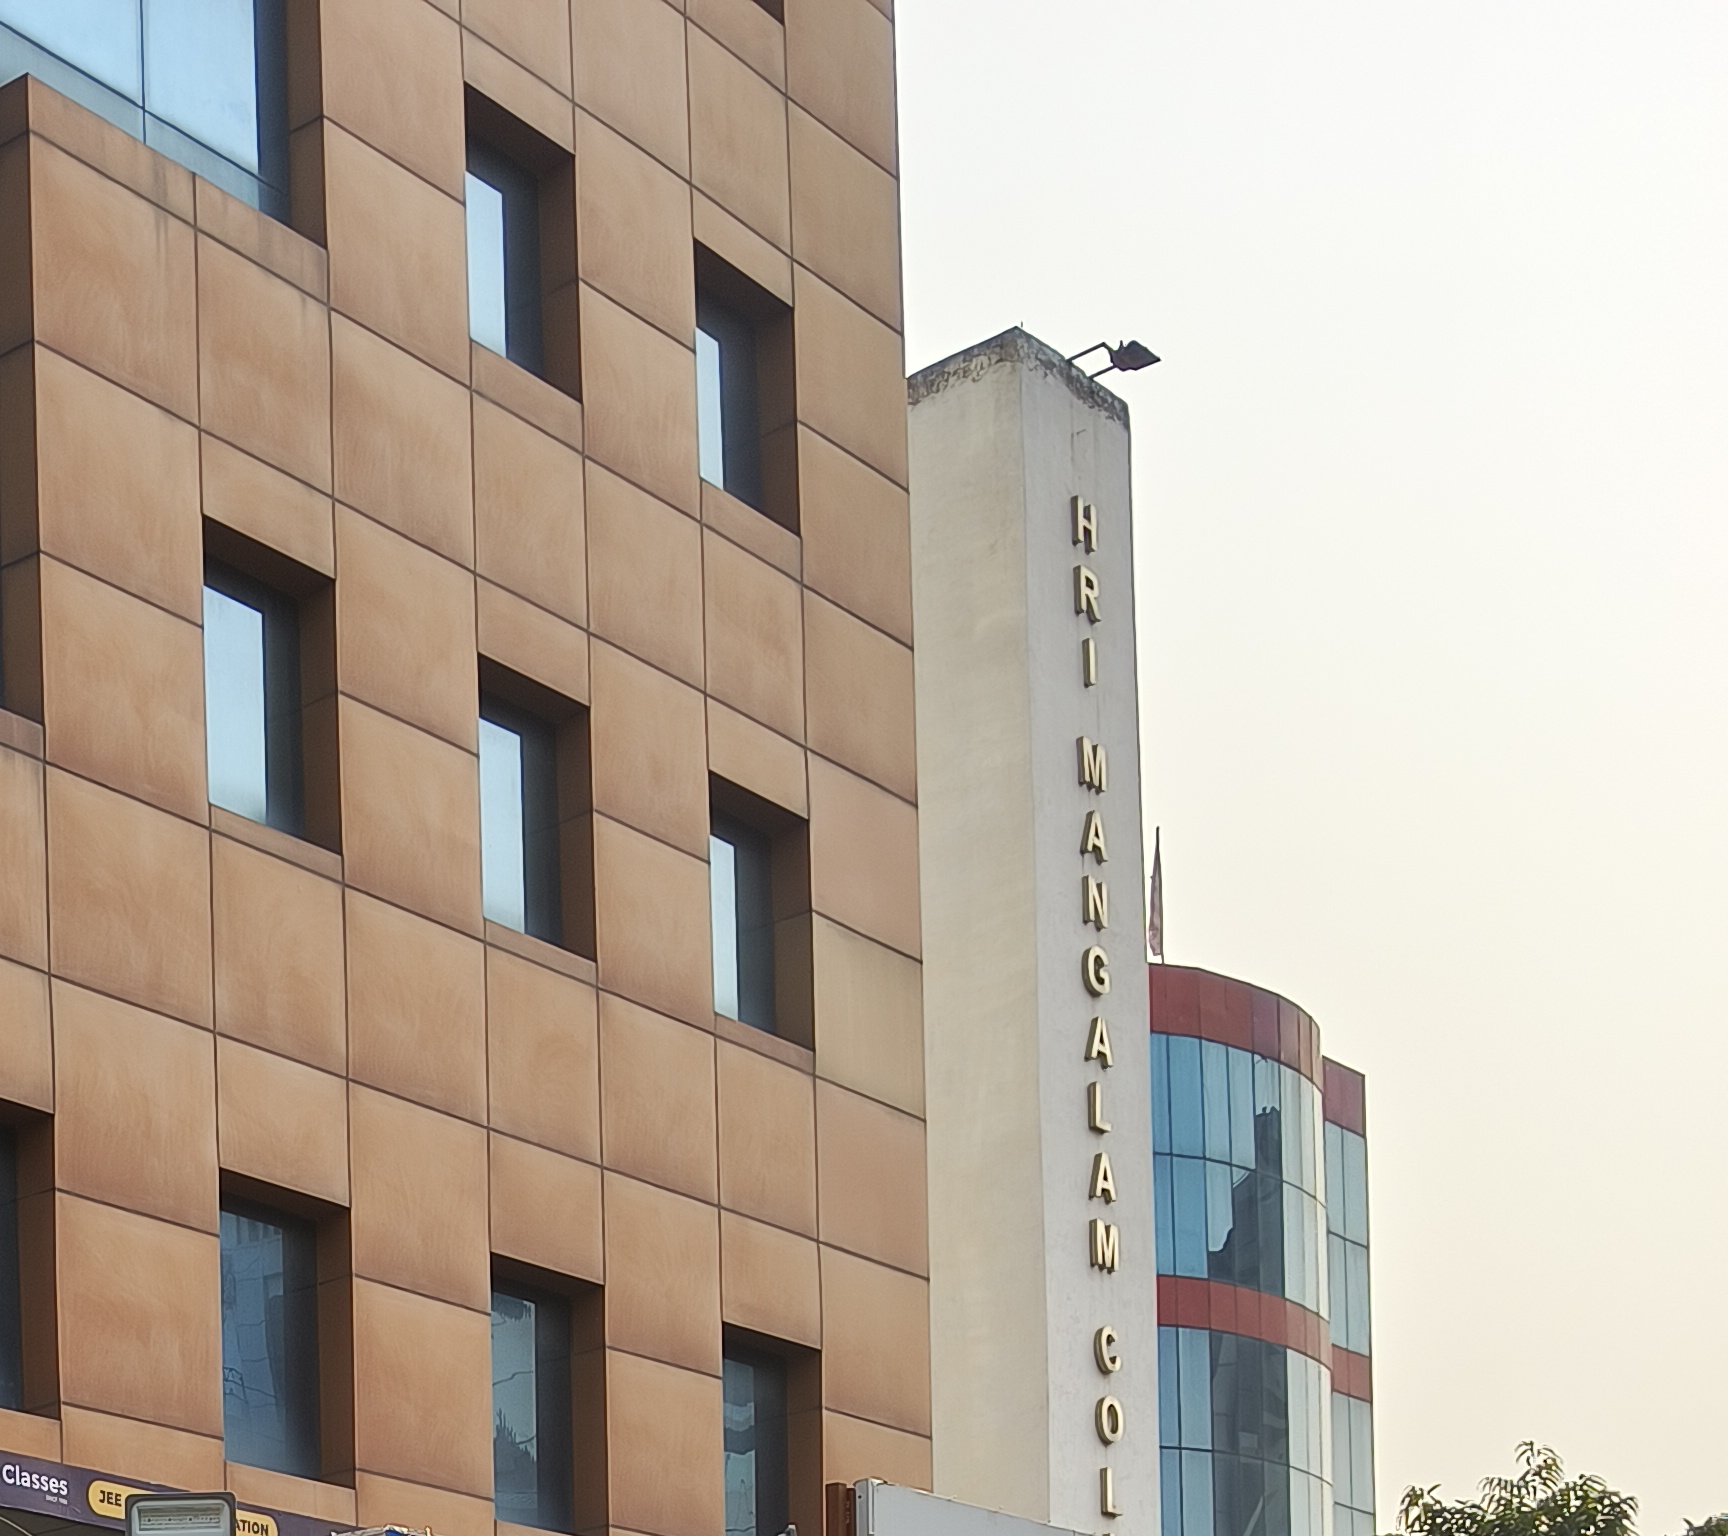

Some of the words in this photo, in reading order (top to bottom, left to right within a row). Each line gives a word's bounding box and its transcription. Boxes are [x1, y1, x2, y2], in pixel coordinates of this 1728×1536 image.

[1071, 494, 1102, 688] HRI
[1075, 735, 1122, 1276] MANGALAM
[2, 1464, 68, 1497] Classes
[99, 1489, 122, 1508] JEE
